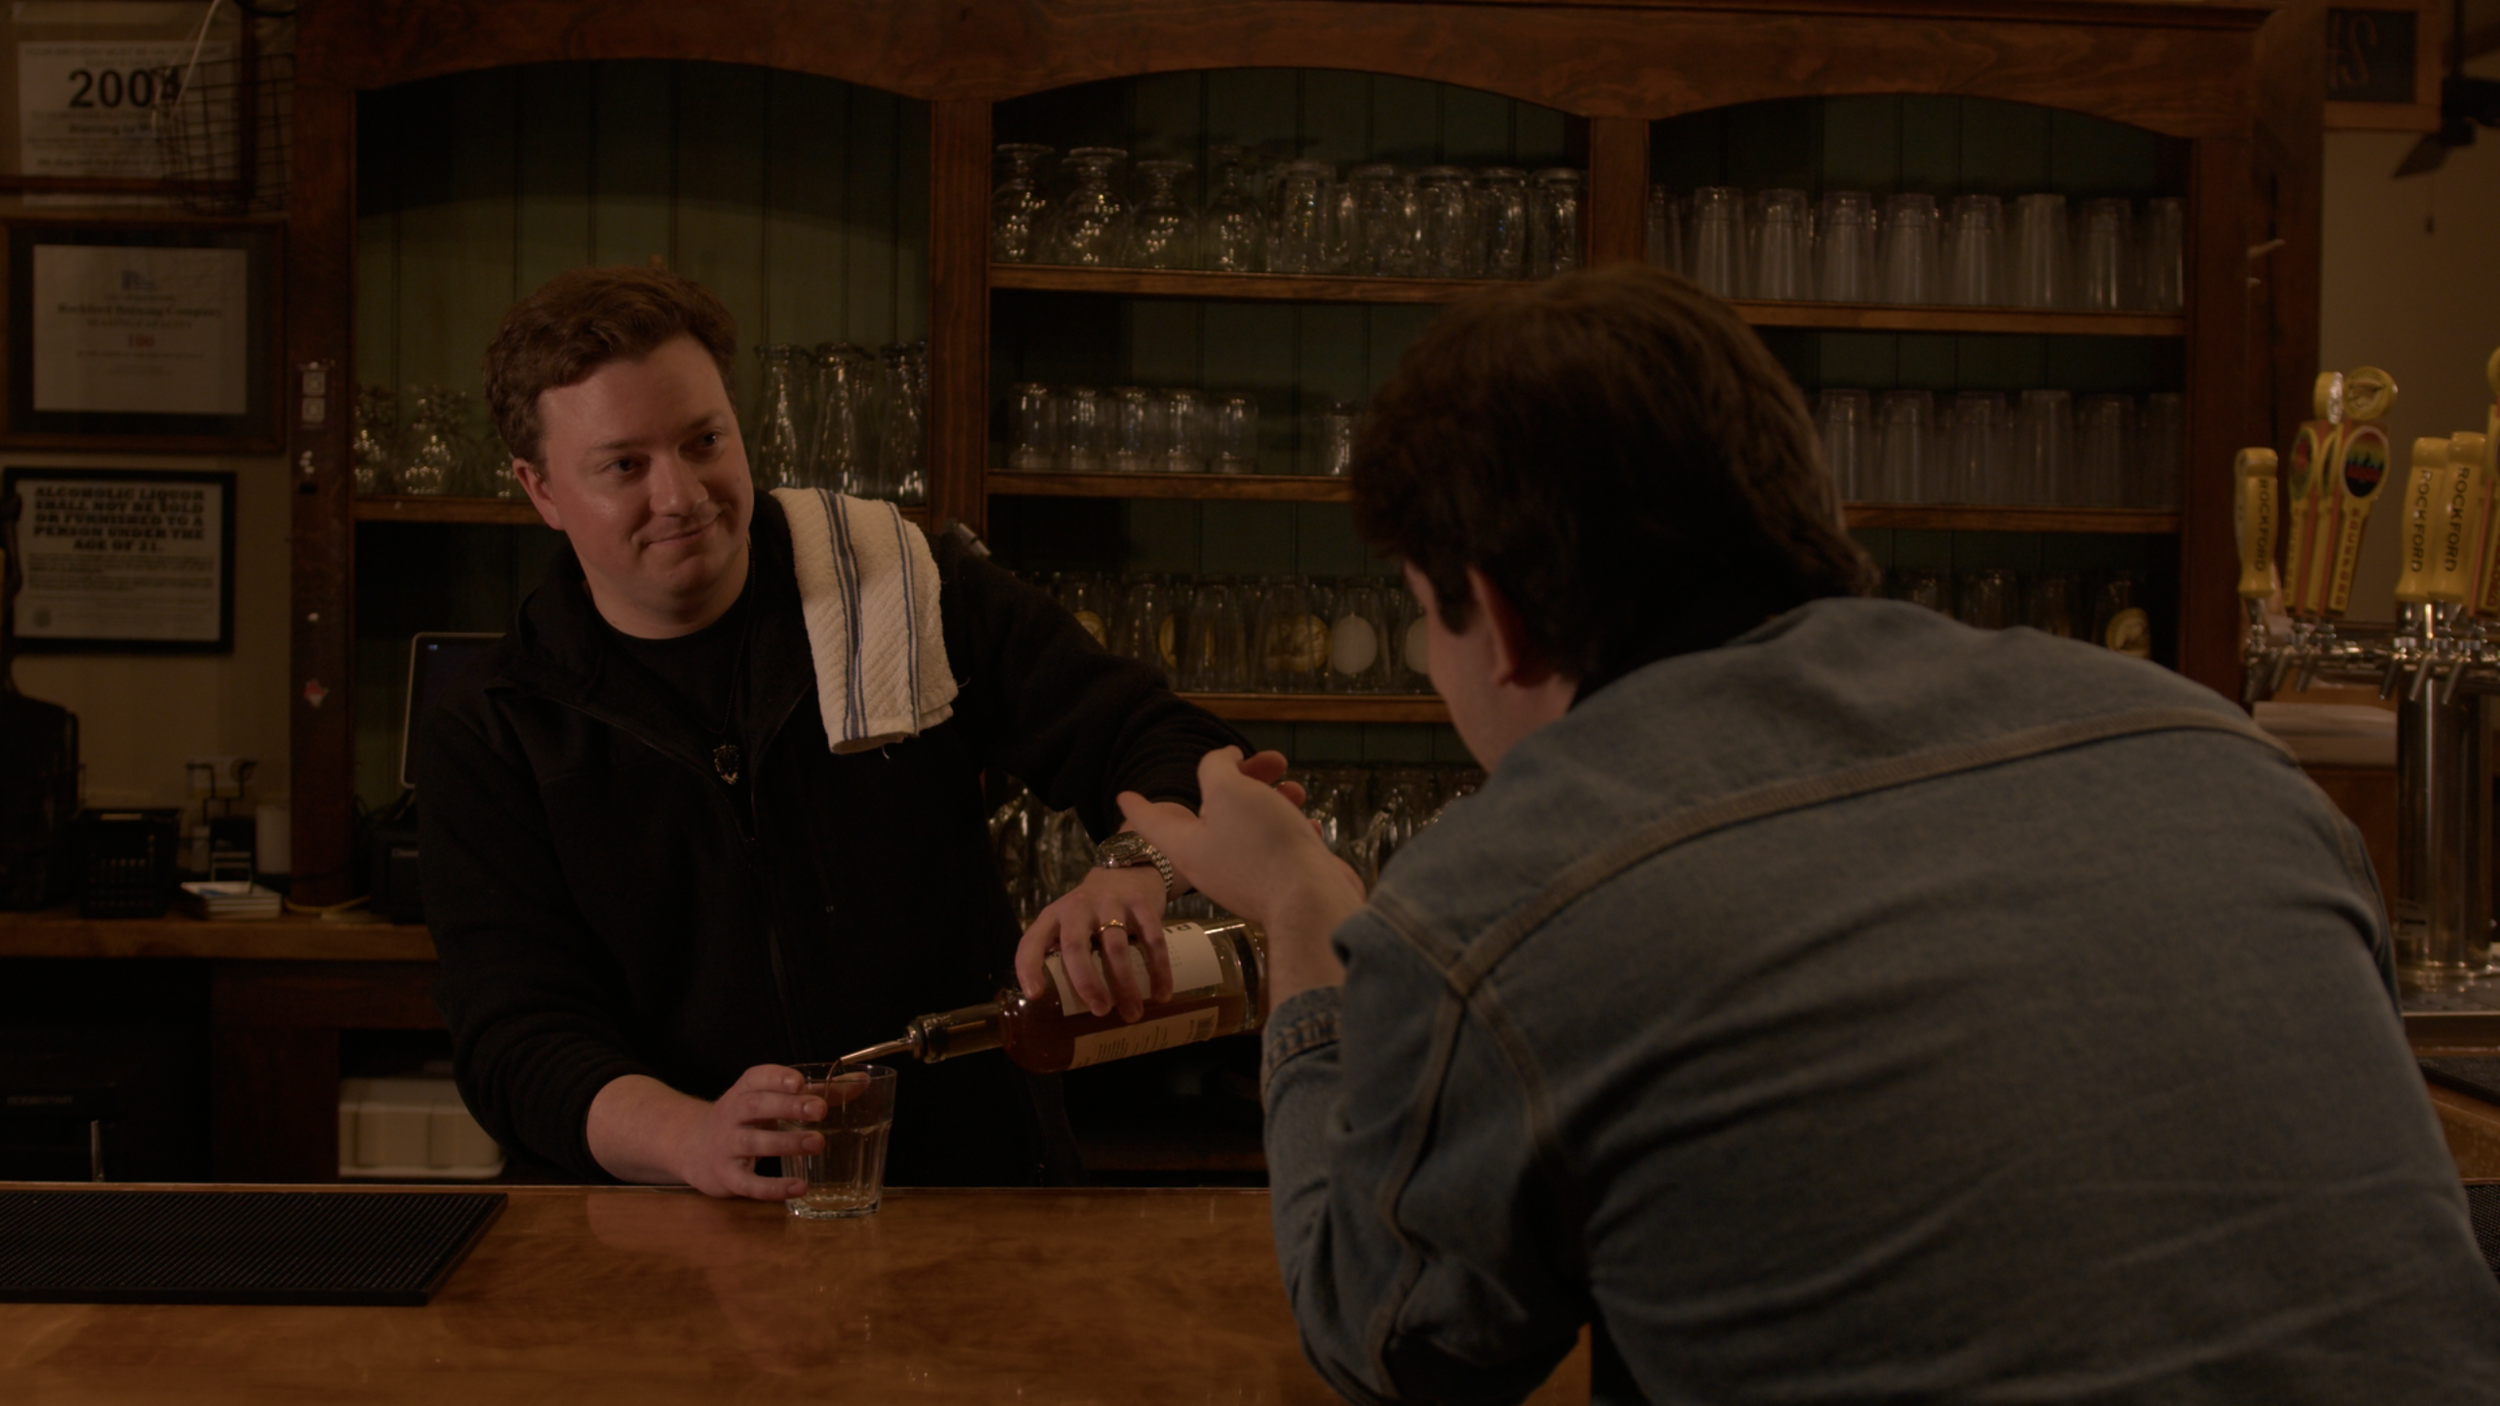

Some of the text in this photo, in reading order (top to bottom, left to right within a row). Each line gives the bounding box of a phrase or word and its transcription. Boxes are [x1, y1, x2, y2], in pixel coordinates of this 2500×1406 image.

[34, 486, 204, 502] ALCOHOLIC LIQUOR
[35, 500, 204, 513] SHALL NOT BE SOLD
[35, 513, 204, 527] OR FURNISHED TO A
[2255, 478, 2270, 571] ROCKFORD
[2411, 469, 2433, 573] ROCKFORD
[2445, 466, 2470, 573] ROCKFORD
[33, 525, 204, 540] PERSON UNDER THE
[73, 538, 107, 551] AGE
[112, 540, 135, 551] OF
